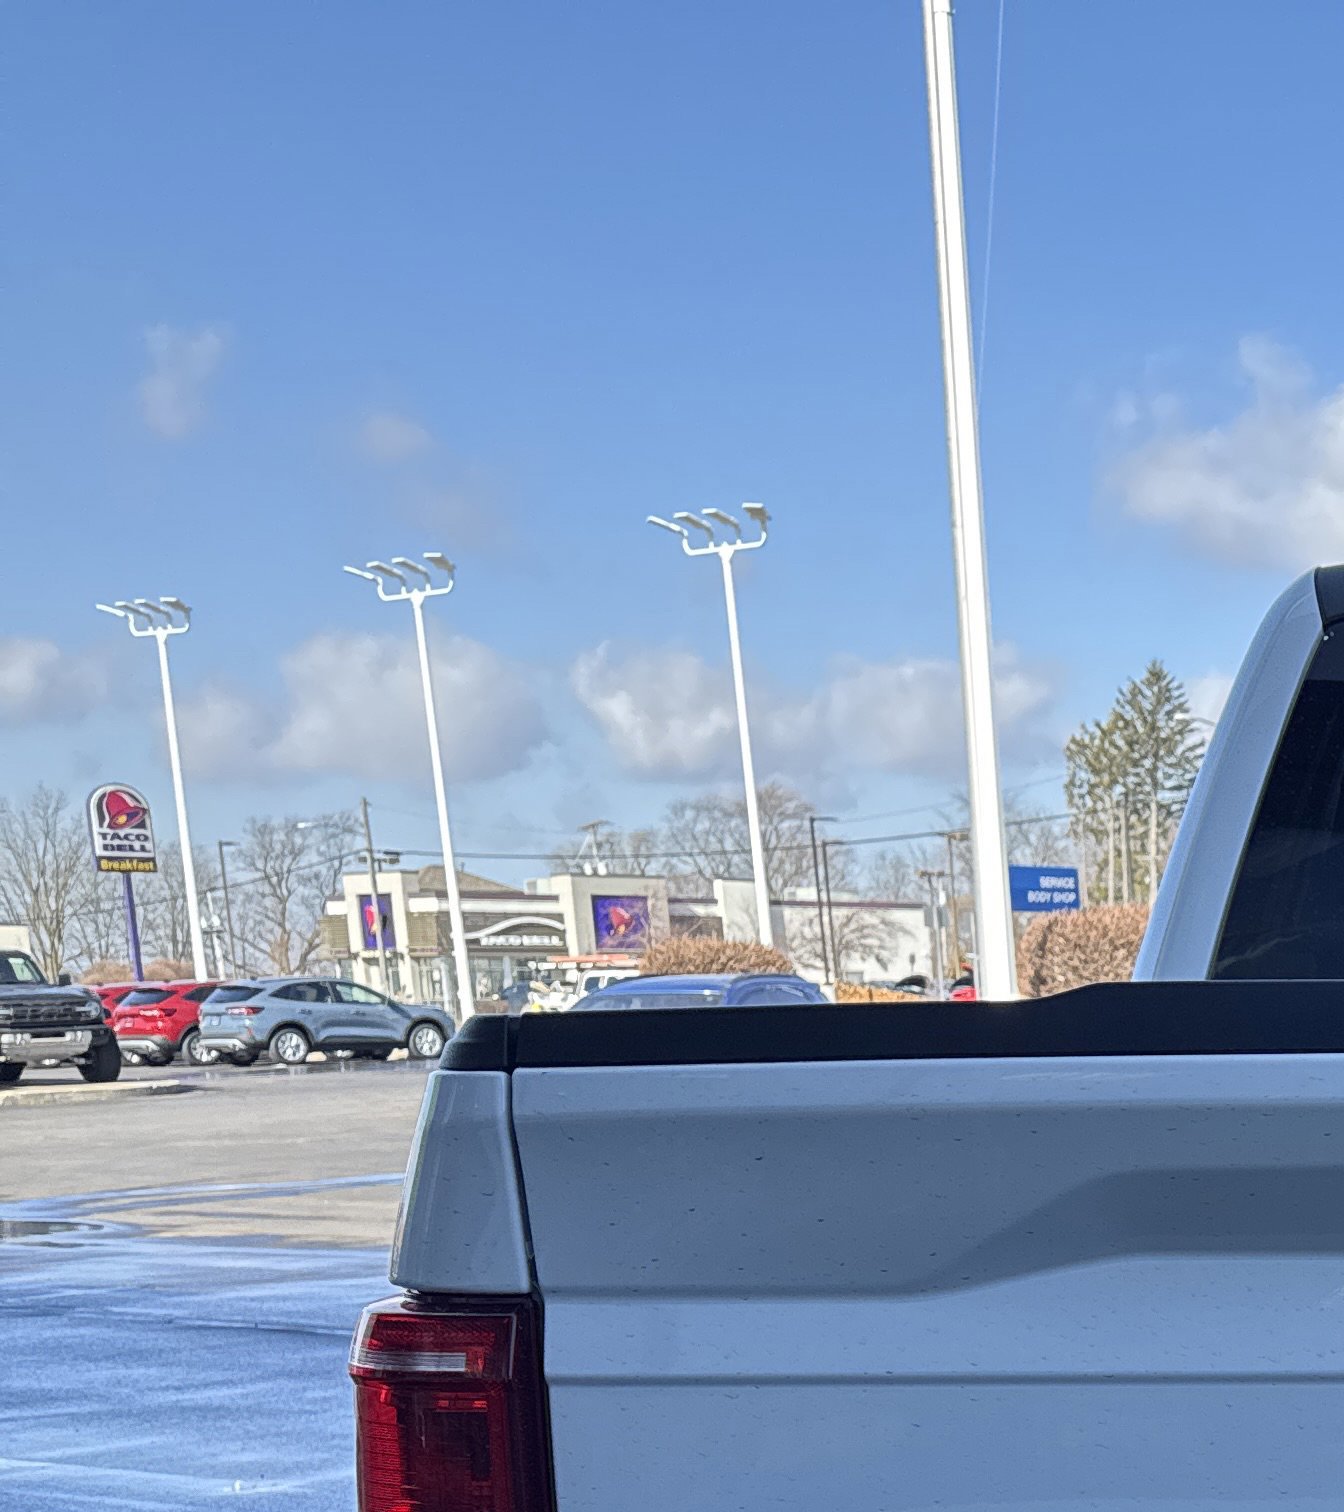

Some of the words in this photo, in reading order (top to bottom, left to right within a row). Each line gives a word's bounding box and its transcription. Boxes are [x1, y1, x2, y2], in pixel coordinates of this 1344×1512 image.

[98, 831, 149, 842] TACO
[103, 843, 151, 853] BELL
[100, 859, 154, 870] Breakfast
[1039, 876, 1075, 889] SERVICE
[1027, 890, 1051, 903] BODY
[1053, 891, 1076, 903] SHOP
